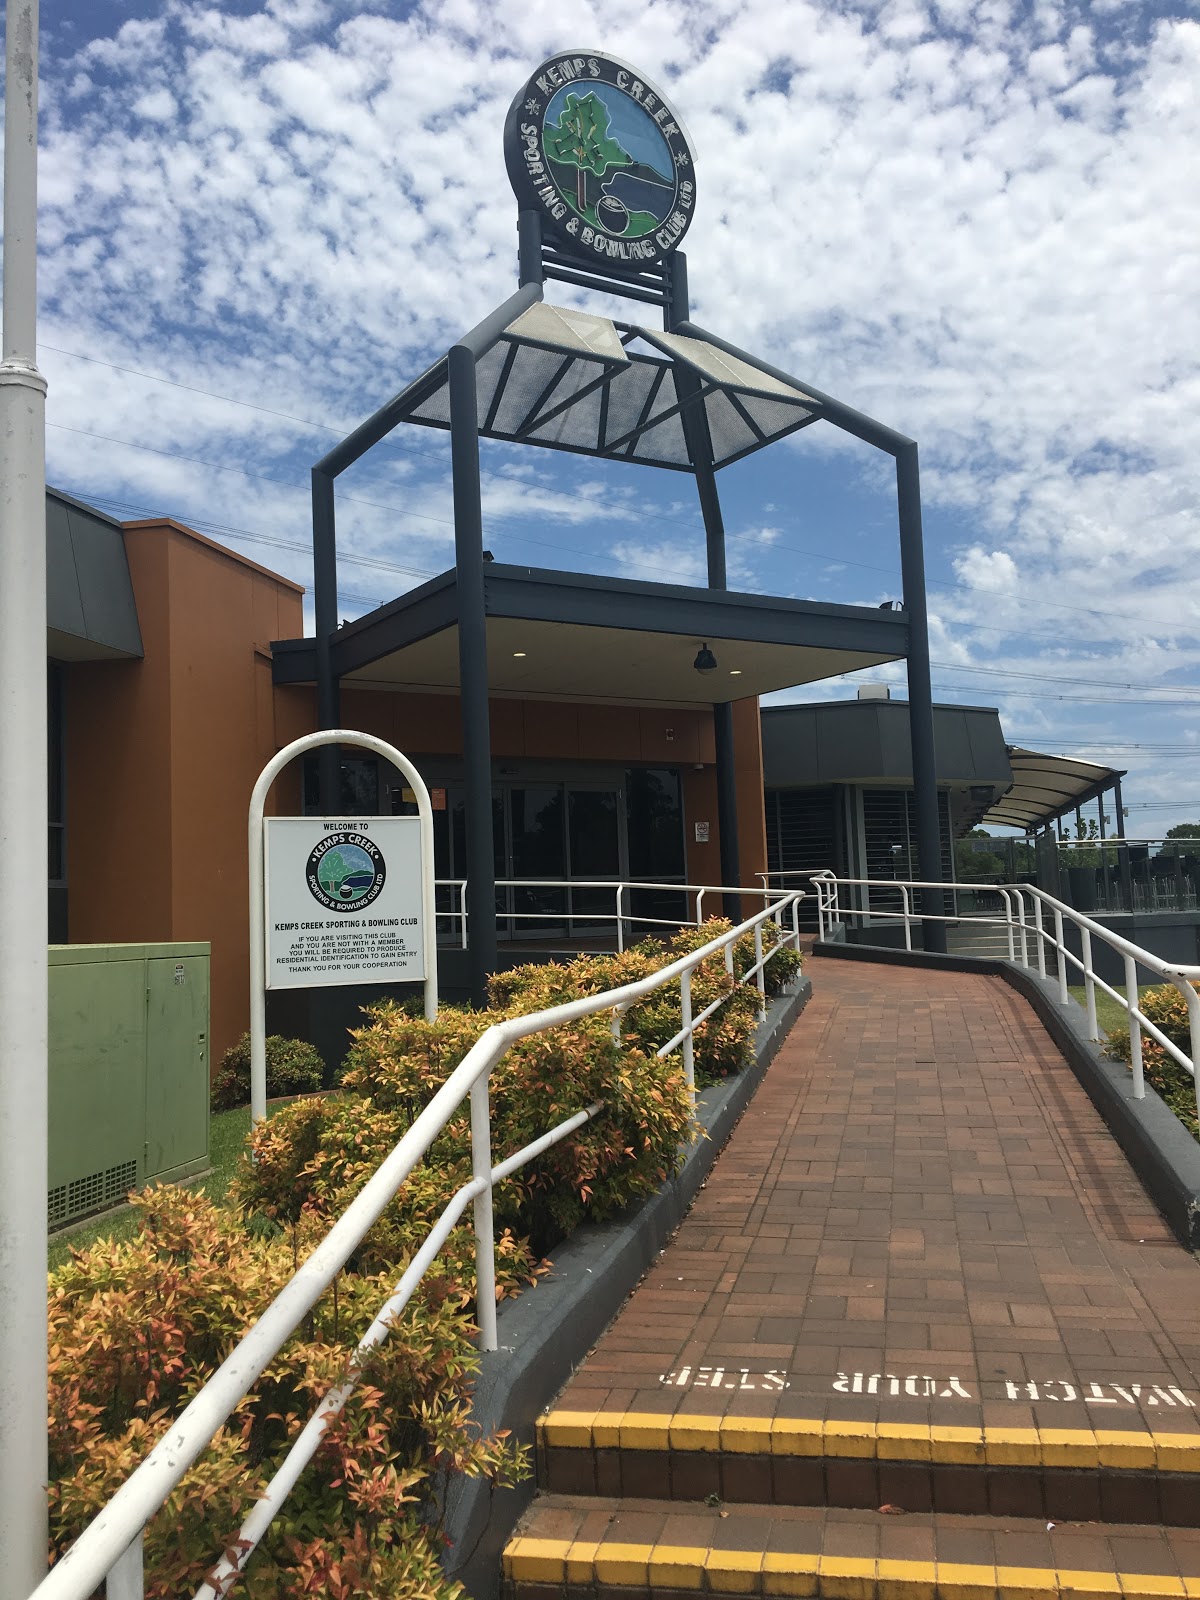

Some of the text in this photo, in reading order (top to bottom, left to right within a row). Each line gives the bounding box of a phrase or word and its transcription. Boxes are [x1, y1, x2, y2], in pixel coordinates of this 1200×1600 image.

[535, 58, 680, 138] KEMPS CREEK
[520, 122, 693, 260] SPORTING & BOWLING CLUB LTD
[313, 834, 378, 858] KEMPS CREEK
[309, 875, 330, 904] SPORTING
[336, 898, 368, 910] BOWLING
[367, 885, 380, 900] CLUB
[275, 922, 299, 931] KEMPS
[300, 922, 324, 930] CREEK
[326, 920, 360, 928] SPORTING
[368, 918, 399, 926] BOWLING
[321, 954, 369, 962] IDENTIFICATION
[362, 961, 407, 969] COOPERATION
[659, 1366, 1196, 1407] WATCH YOUR STEP
